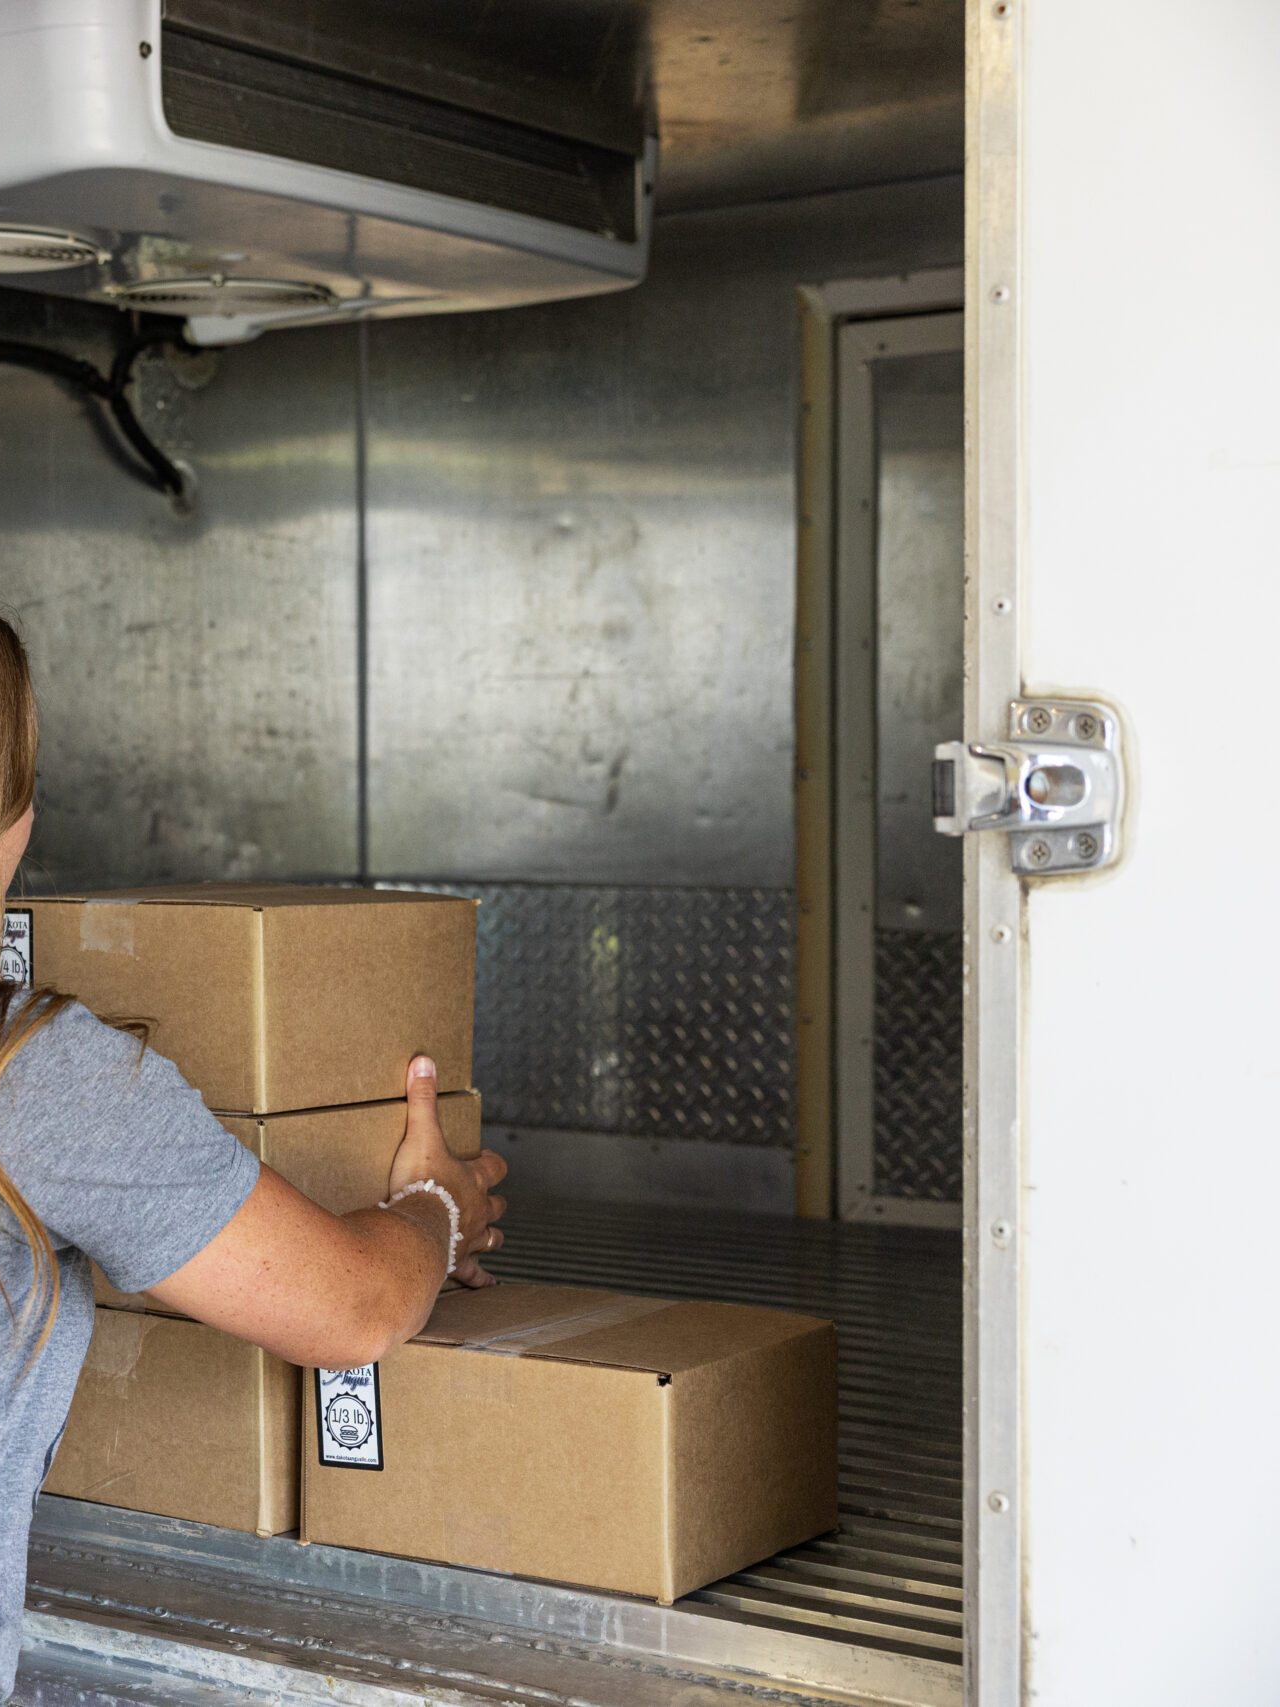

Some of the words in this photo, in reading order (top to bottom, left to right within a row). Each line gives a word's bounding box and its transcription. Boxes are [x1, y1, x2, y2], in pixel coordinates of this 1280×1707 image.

[8, 920, 28, 929] KOTA
[0, 959, 9, 973] /4
[11, 959, 24, 974] lb.
[331, 1408, 350, 1424] 1/3
[353, 1409, 368, 1425] lb.
